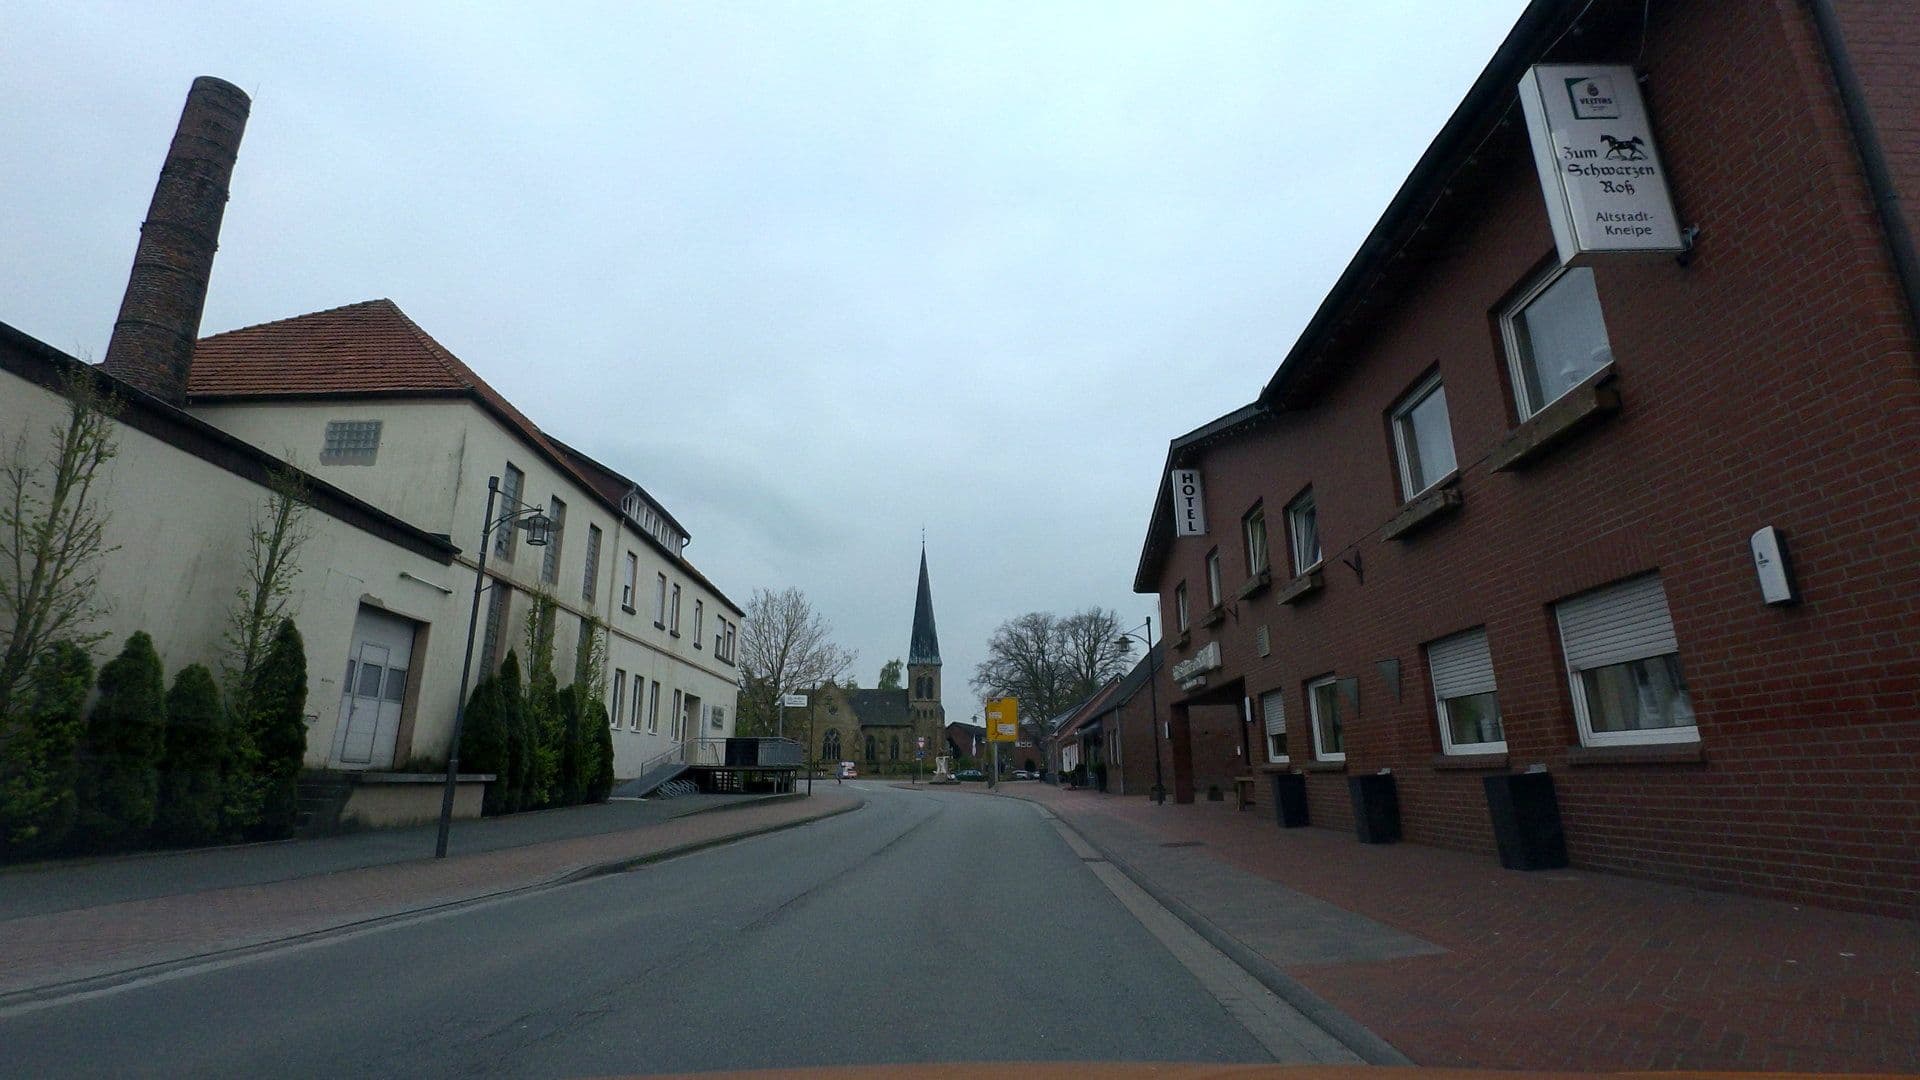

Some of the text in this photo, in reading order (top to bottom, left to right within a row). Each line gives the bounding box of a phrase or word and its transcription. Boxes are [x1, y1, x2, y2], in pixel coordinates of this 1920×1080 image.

[1563, 146, 1598, 160] Zum
[1567, 163, 1655, 179] Schwarzen
[1599, 181, 1635, 196] Roß
[1596, 211, 1654, 222] Altstadt-
[1605, 225, 1652, 237] Kneipe
[1181, 473, 1196, 532] HOTEL
